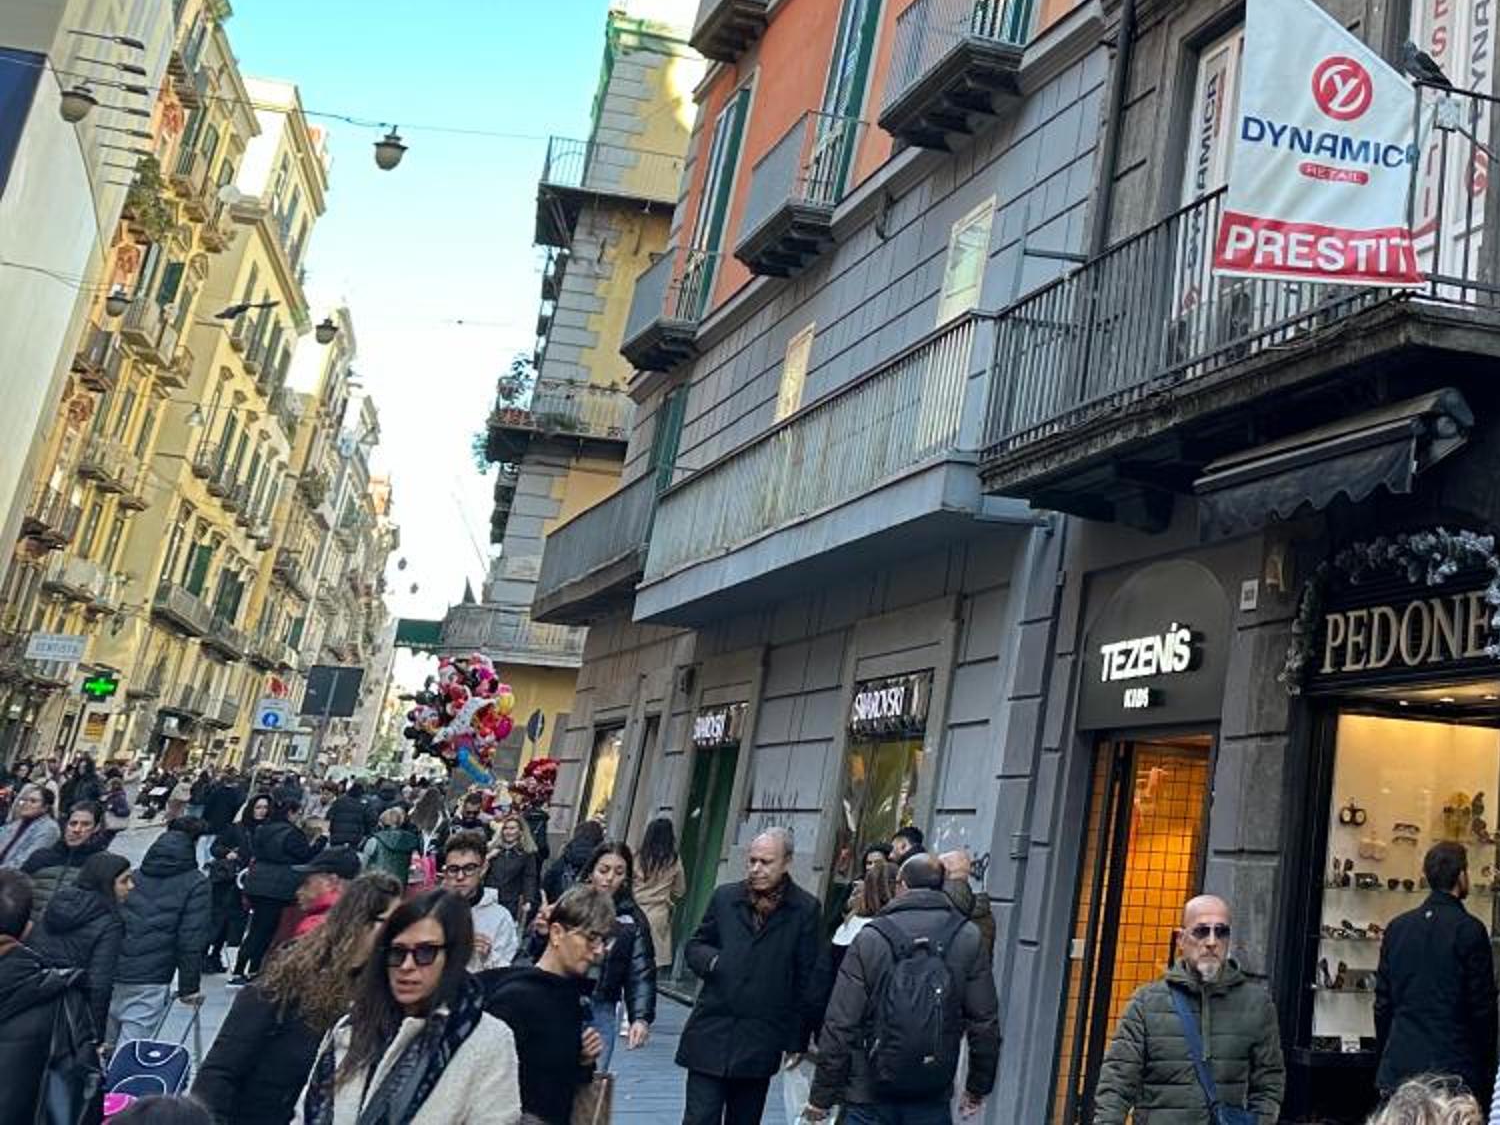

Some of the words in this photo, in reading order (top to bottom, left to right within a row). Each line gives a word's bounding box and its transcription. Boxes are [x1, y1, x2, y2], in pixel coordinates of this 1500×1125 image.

[1101, 622, 1190, 682] TEZENIS
[1319, 589, 1491, 674] PEDONE
[1123, 686, 1149, 708] KIDS
